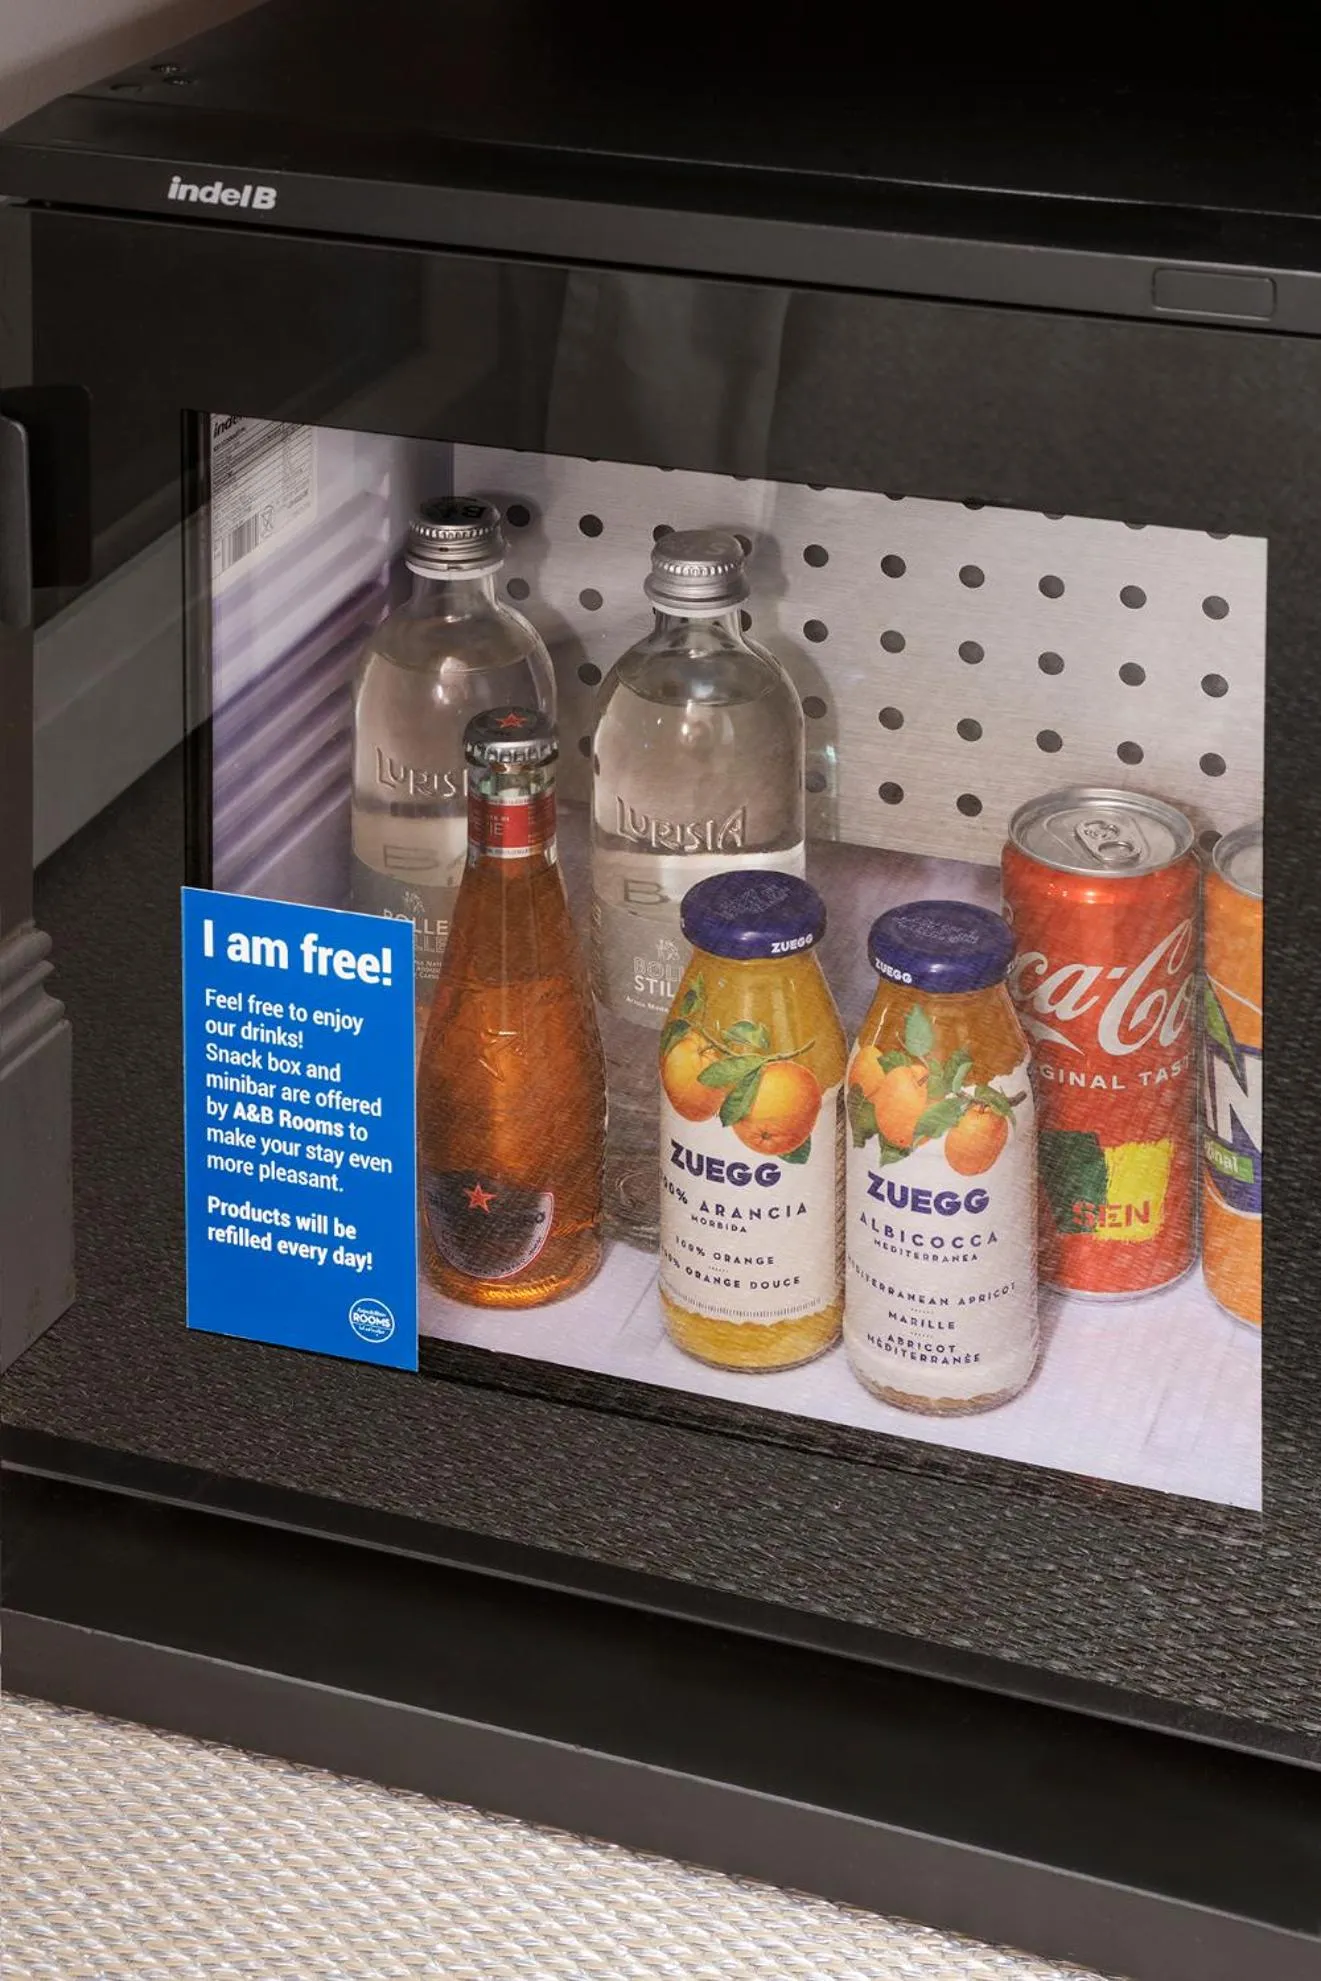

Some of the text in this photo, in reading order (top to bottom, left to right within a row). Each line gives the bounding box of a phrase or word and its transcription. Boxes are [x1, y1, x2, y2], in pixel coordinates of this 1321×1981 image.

[204, 919, 213, 957] I
[227, 933, 288, 969] am
[300, 933, 391, 986] free!
[771, 934, 814, 953] ZUEGG
[875, 957, 913, 984] ZUEGG
[635, 975, 675, 998] STIL
[206, 989, 363, 1035] Feel free to enjoy
[206, 1020, 303, 1048] our drinks!
[206, 1043, 340, 1082] Snack box and
[1040, 1065, 1126, 1090] GINAL
[207, 1072, 381, 1116] minibar are offered
[207, 1096, 368, 1141] by A&B Rooms to
[207, 1128, 392, 1173] make your stay even
[671, 1138, 781, 1187] ZUEGG
[208, 1155, 342, 1191] more pleasant.
[867, 1170, 990, 1216] ZUEGG
[208, 1196, 356, 1239] Products will be
[691, 1214, 748, 1233] MORBIDA
[699, 1200, 807, 1221] ARANCIA
[859, 1211, 998, 1249] ALBICOCCA
[208, 1225, 372, 1272] refilled every day!
[713, 1252, 775, 1266] ORANGE
[873, 1239, 979, 1264] MEDITERRANEA
[685, 1266, 741, 1289] ORANGE
[750, 1275, 801, 1290] DOUCE
[958, 1281, 1016, 1306] APRICOT
[888, 1310, 956, 1330] MARILLE
[887, 1334, 957, 1353] ABRICOT
